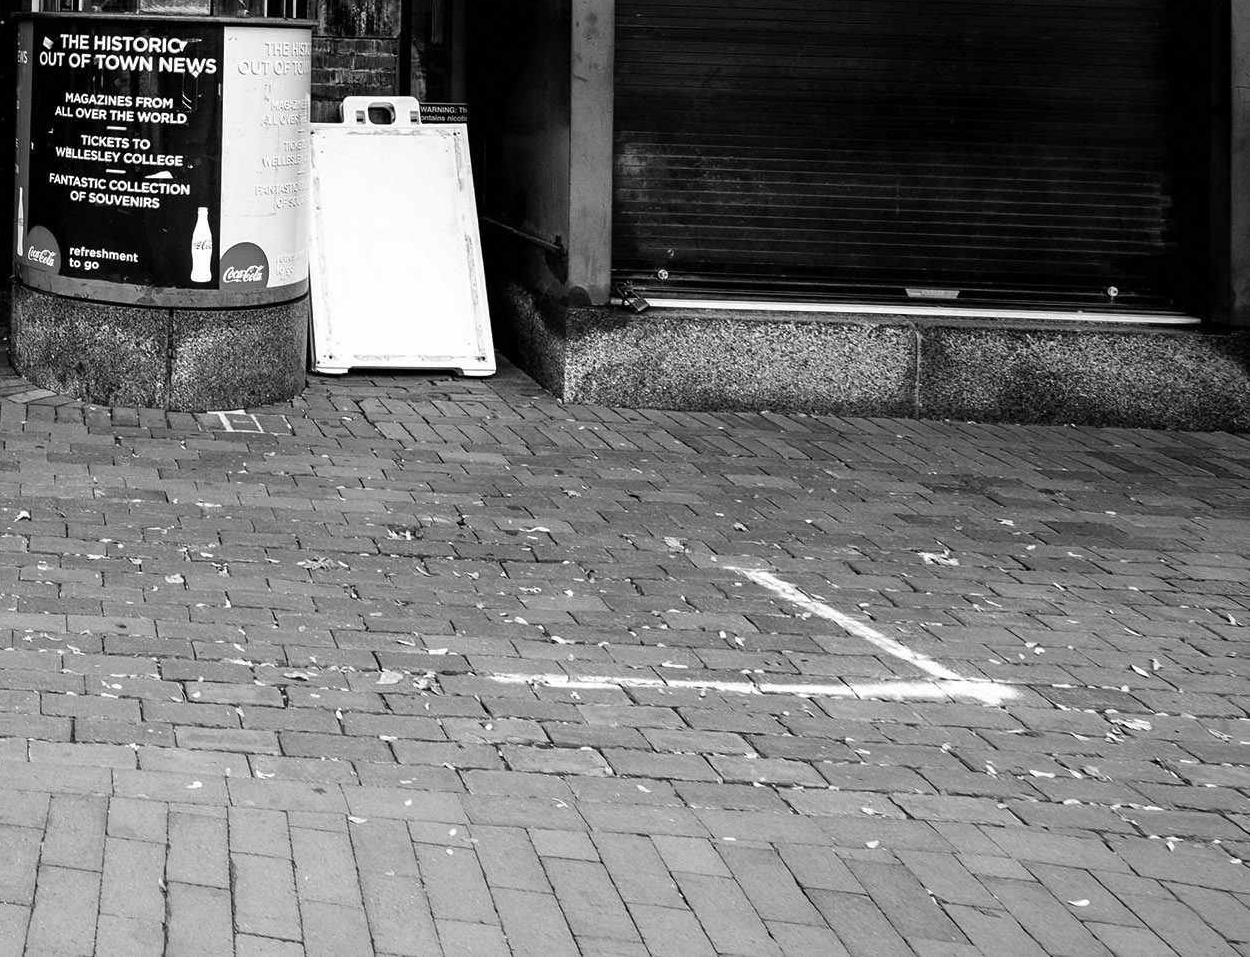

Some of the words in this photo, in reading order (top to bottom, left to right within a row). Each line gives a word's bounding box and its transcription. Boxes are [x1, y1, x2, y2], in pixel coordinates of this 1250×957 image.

[60, 34, 90, 50] THE
[94, 35, 182, 54] HISTORIC
[264, 42, 290, 57] THE
[39, 51, 66, 67] OUT
[68, 52, 92, 69] OF
[95, 54, 153, 71] TOWN
[158, 56, 217, 74] NEWS
[237, 60, 271, 76] OUT
[273, 60, 291, 76] OF
[65, 92, 133, 107] MAGAZINES
[135, 96, 174, 109] FROM
[55, 106, 74, 117] ALL
[75, 108, 107, 120] OVER
[109, 110, 135, 122] THE
[137, 111, 187, 125] WORLD
[81, 134, 130, 149] TICKETS
[132, 138, 151, 150] TO
[55, 146, 121, 163] WELLESLEY
[123, 153, 184, 167] COLLEGE
[49, 173, 107, 190] FANTASTIC
[108, 180, 191, 195] COLLECTION
[70, 190, 87, 202] OF
[88, 192, 161, 209] SOUVENIRS
[69, 246, 139, 263] refreshment
[69, 257, 81, 268] to
[84, 260, 100, 271] go
